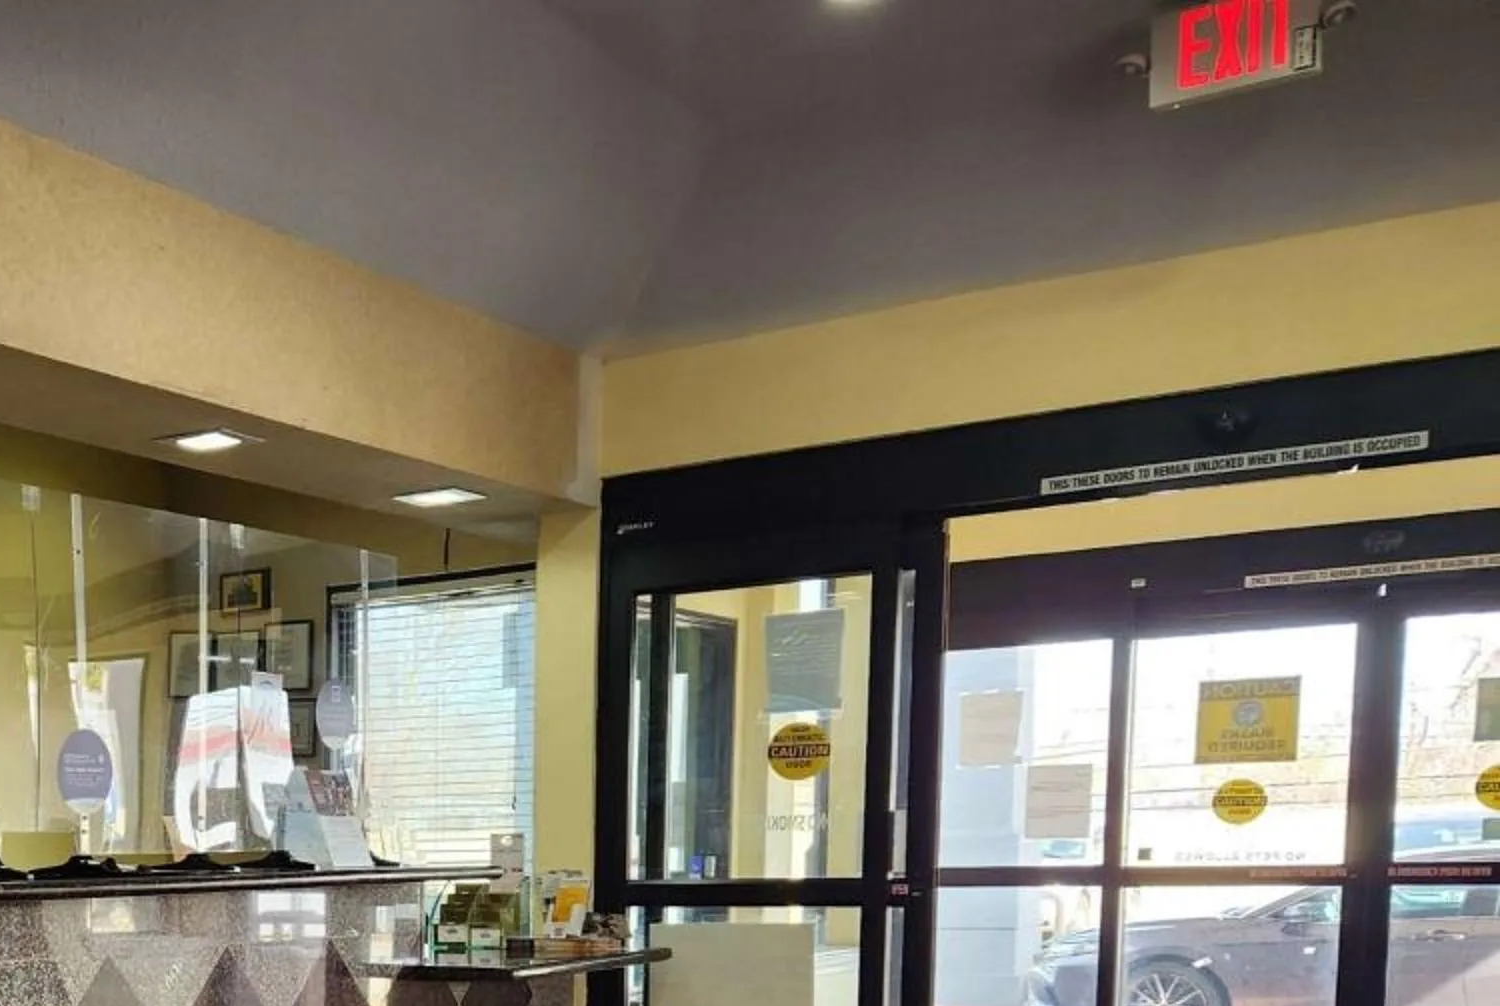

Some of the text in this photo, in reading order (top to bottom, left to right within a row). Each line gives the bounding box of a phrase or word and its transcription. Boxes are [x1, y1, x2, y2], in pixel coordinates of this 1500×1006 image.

[1178, 0, 1289, 90] EXIT
[1072, 475, 1100, 488] THESE
[1103, 471, 1135, 484] DOORS
[1138, 467, 1149, 479] TO
[1153, 462, 1191, 477] REMAIN
[1193, 456, 1244, 473] UNLOCKED
[1248, 451, 1277, 466] WHEN
[1281, 448, 1298, 462] THE
[1303, 443, 1349, 459] BUILDING
[1353, 441, 1364, 453] IS
[1367, 434, 1421, 451] OCCUPIED
[771, 745, 829, 757] CAUTION
